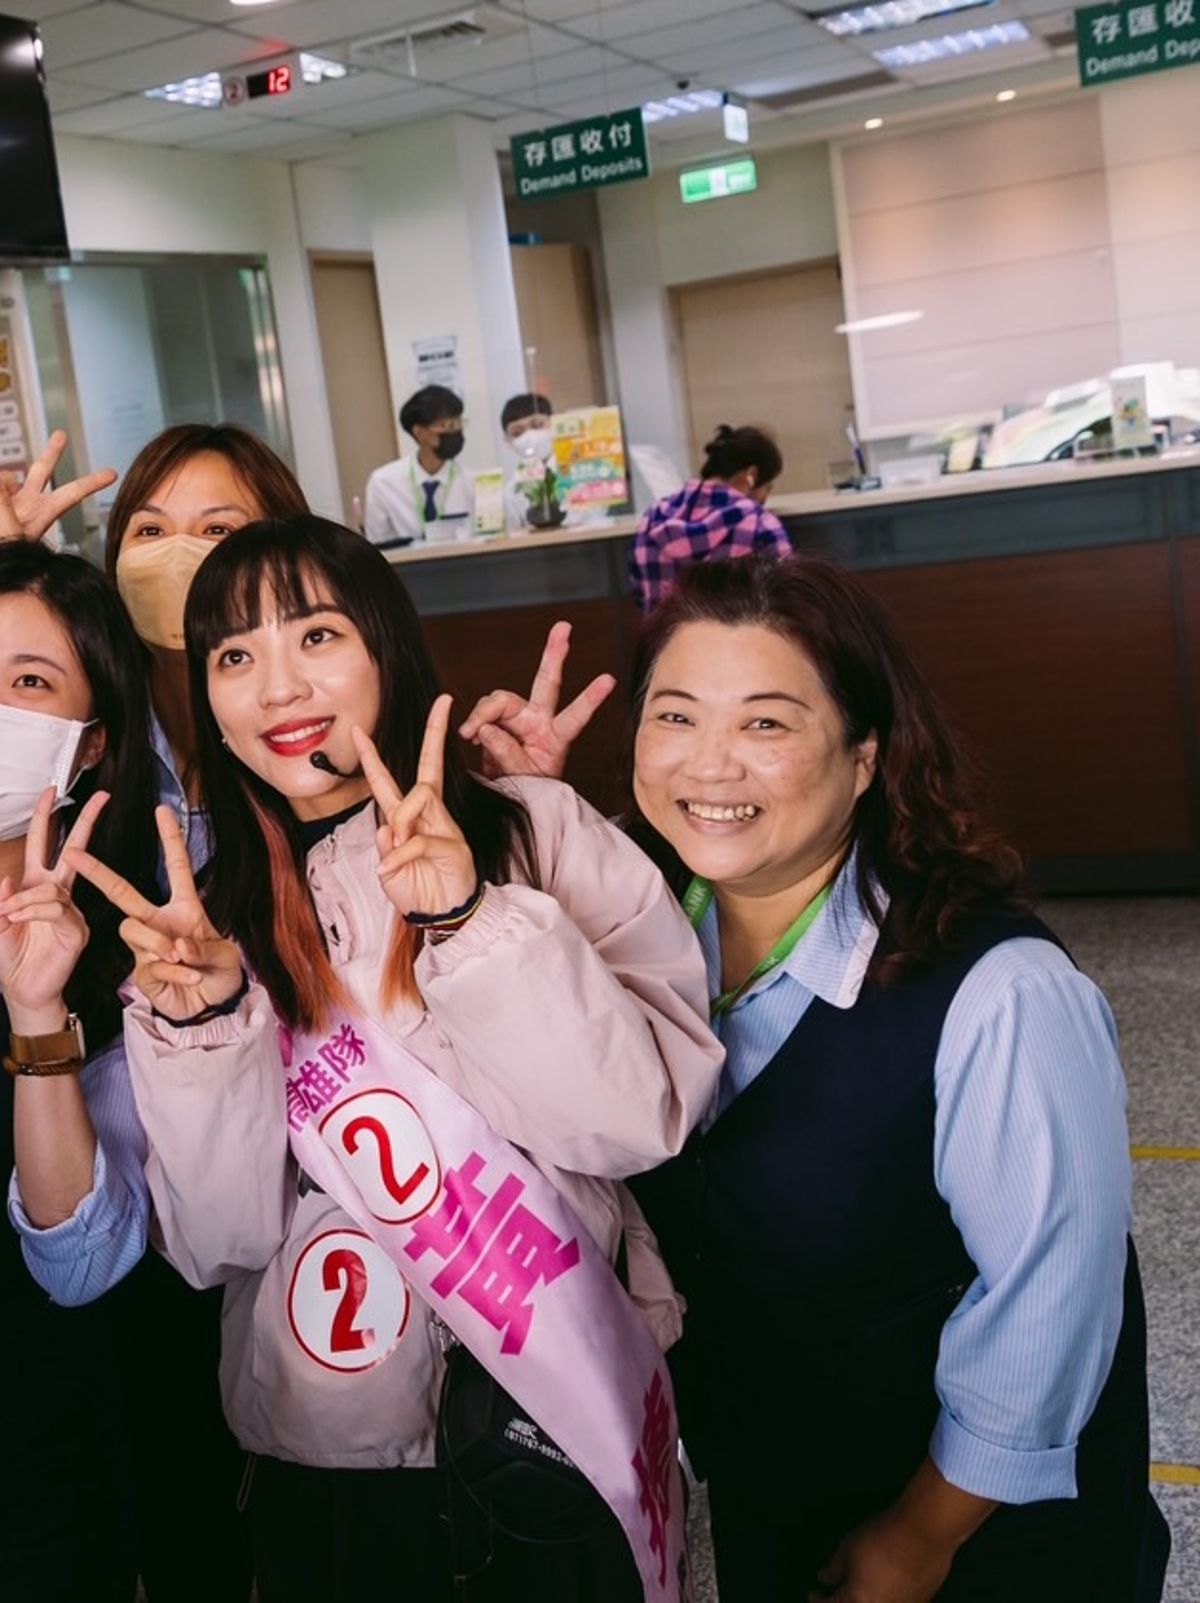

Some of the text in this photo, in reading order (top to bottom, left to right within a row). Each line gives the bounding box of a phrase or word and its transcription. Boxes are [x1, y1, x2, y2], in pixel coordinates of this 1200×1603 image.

[1089, 0, 1196, 45] 存匯收
[268, 66, 290, 92] 12
[1085, 44, 1159, 77] Demand
[523, 121, 632, 167] 存匯收付
[520, 157, 643, 194] Demand Deposits
[341, 1115, 431, 1206] 2
[321, 1248, 376, 1354] 2
